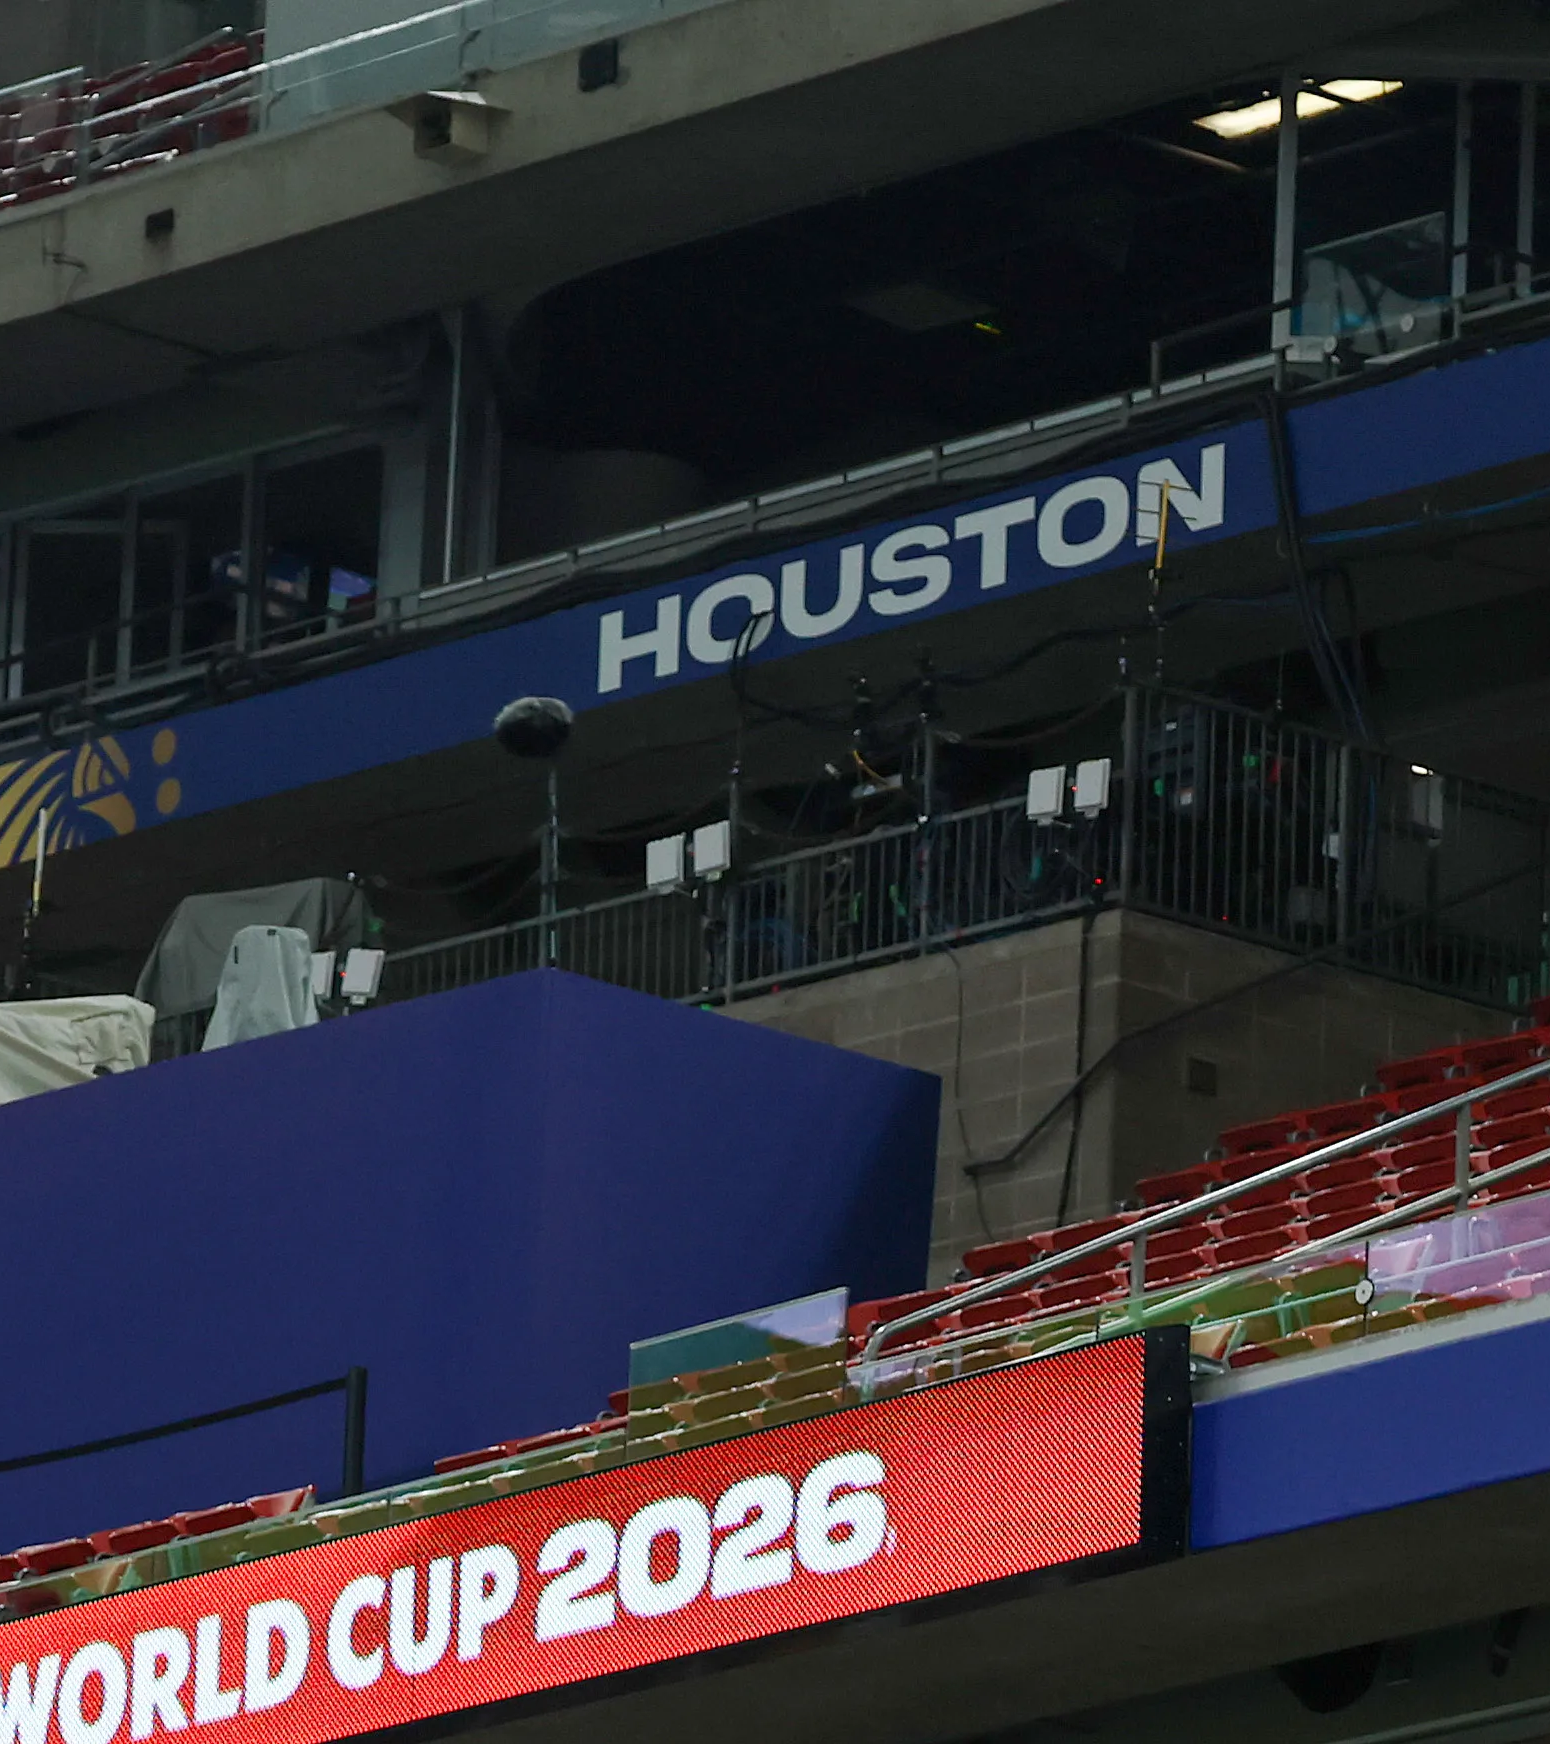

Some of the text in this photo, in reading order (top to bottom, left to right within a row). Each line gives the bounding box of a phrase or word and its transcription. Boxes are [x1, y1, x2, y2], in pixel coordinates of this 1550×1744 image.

[597, 444, 1227, 694] HOUSTON
[327, 1543, 521, 1691] CUP
[534, 1449, 890, 1643] 2026
